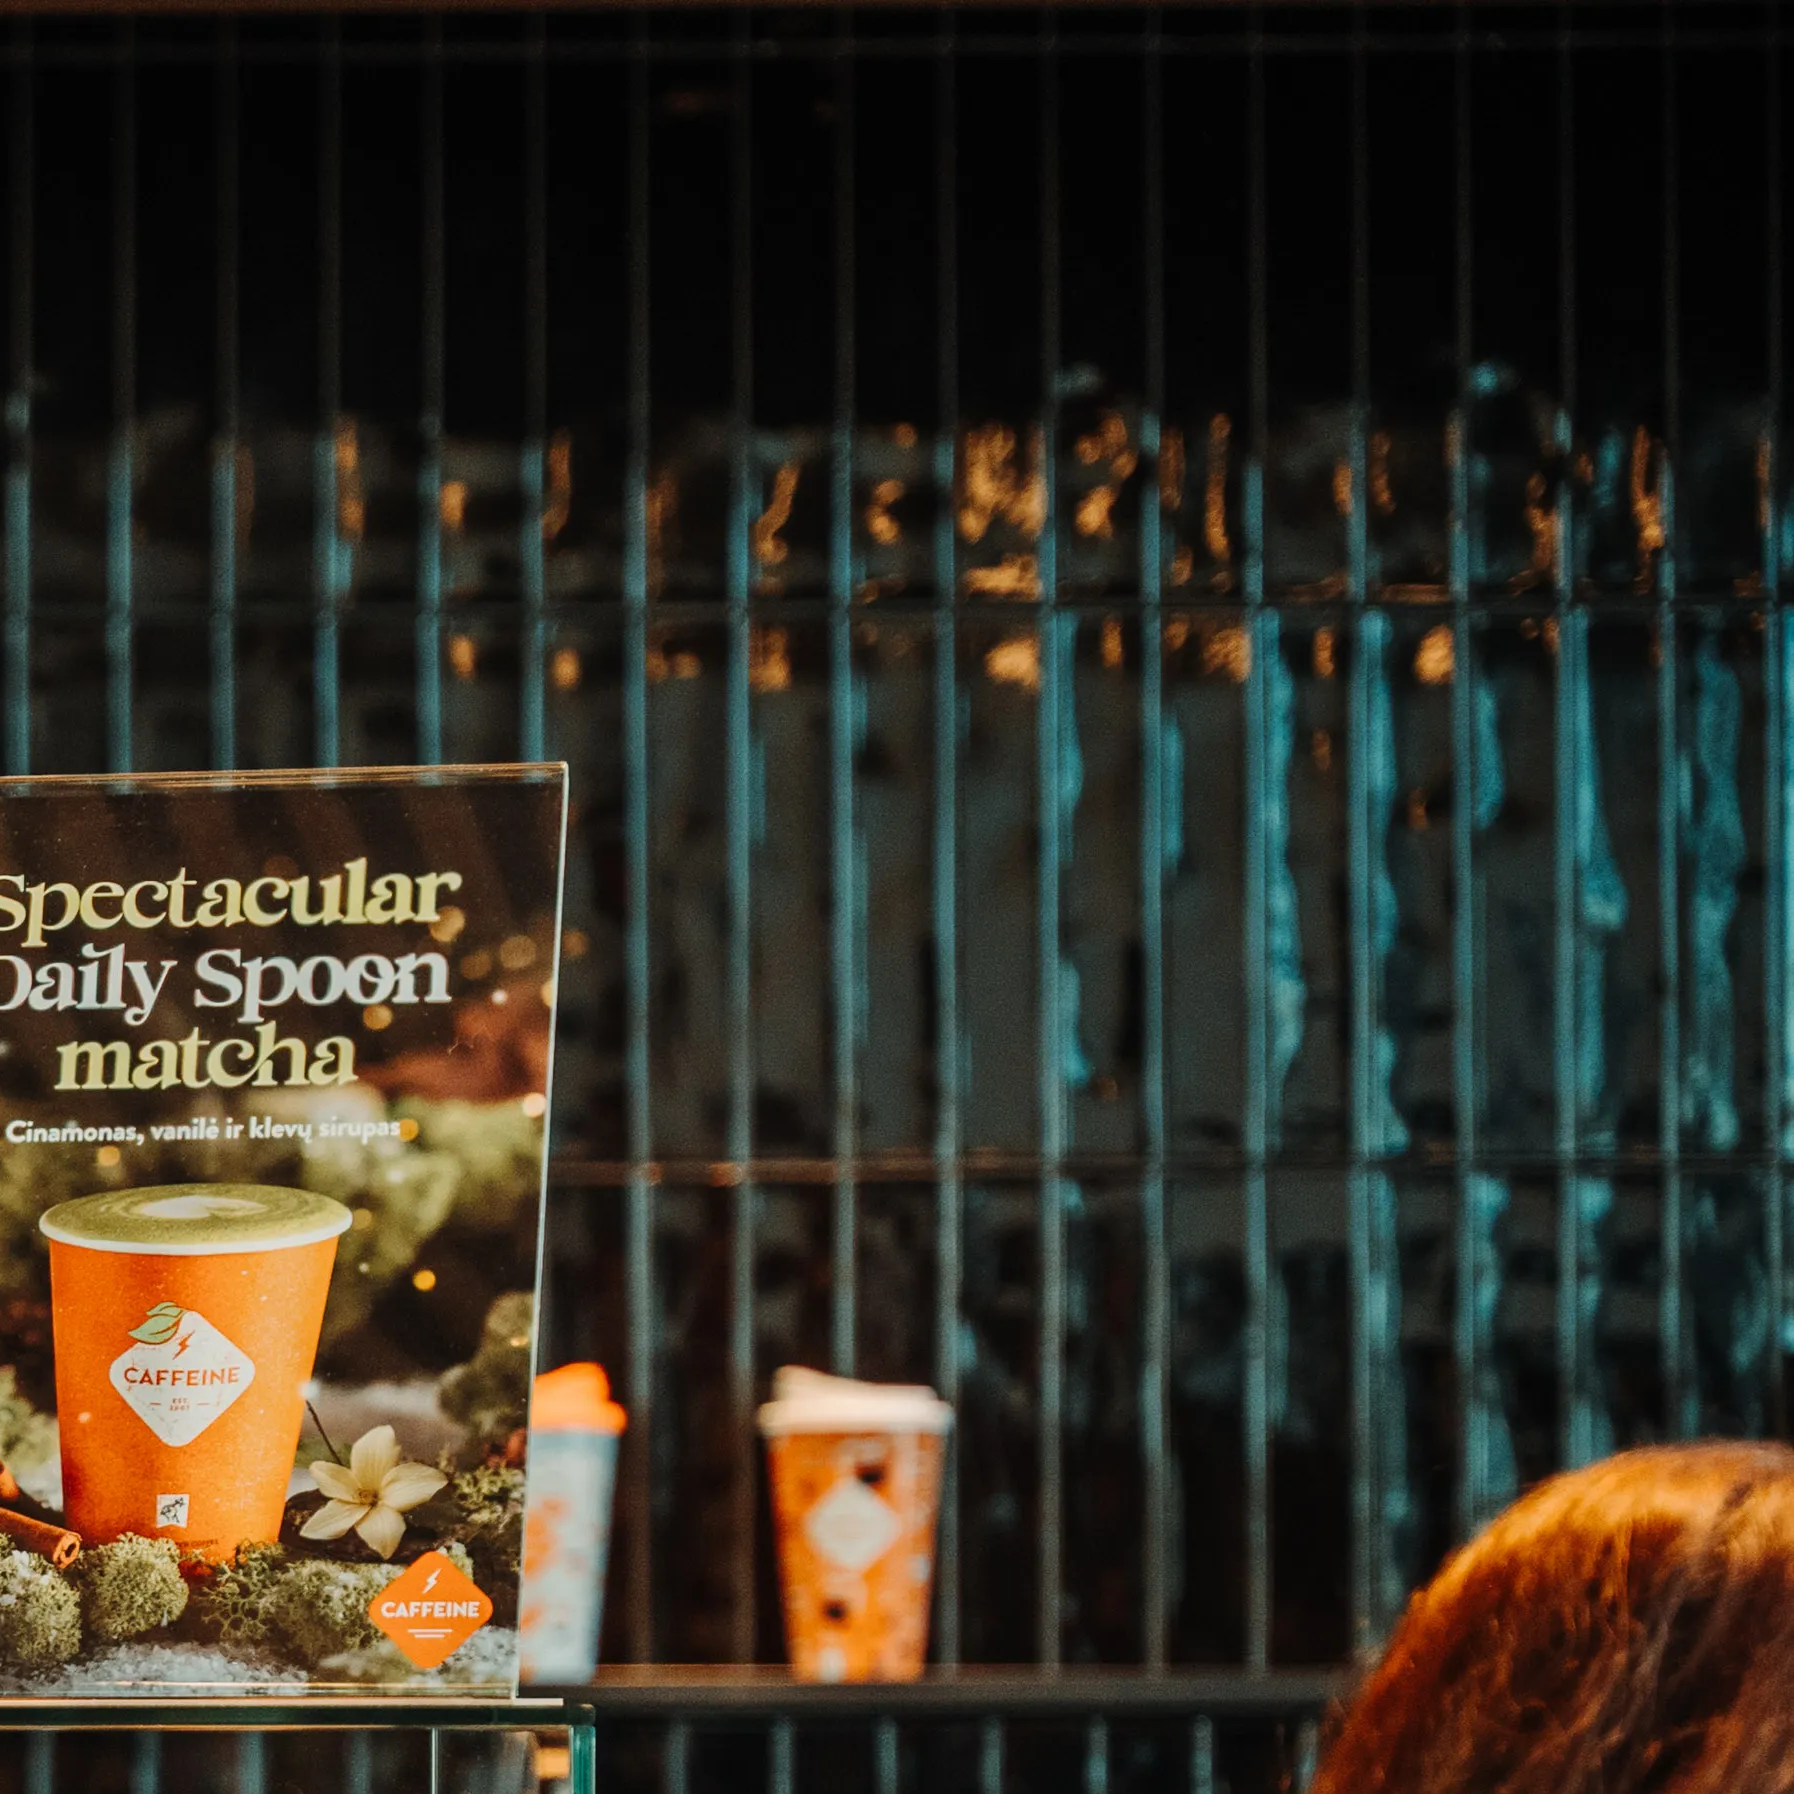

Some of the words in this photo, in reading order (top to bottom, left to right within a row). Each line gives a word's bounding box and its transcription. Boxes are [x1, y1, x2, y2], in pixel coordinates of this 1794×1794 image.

[194, 948, 452, 1024] Spoon
[54, 1020, 358, 1091] matcha
[5, 1119, 145, 1146] Cinamonas,
[152, 1117, 220, 1141] vanilė
[225, 1118, 244, 1140] ir
[249, 1116, 313, 1144] klevų
[319, 1116, 401, 1143] sirupas
[124, 1366, 241, 1386] CAFFEINE
[380, 1599, 481, 1620] CAFFEINE
